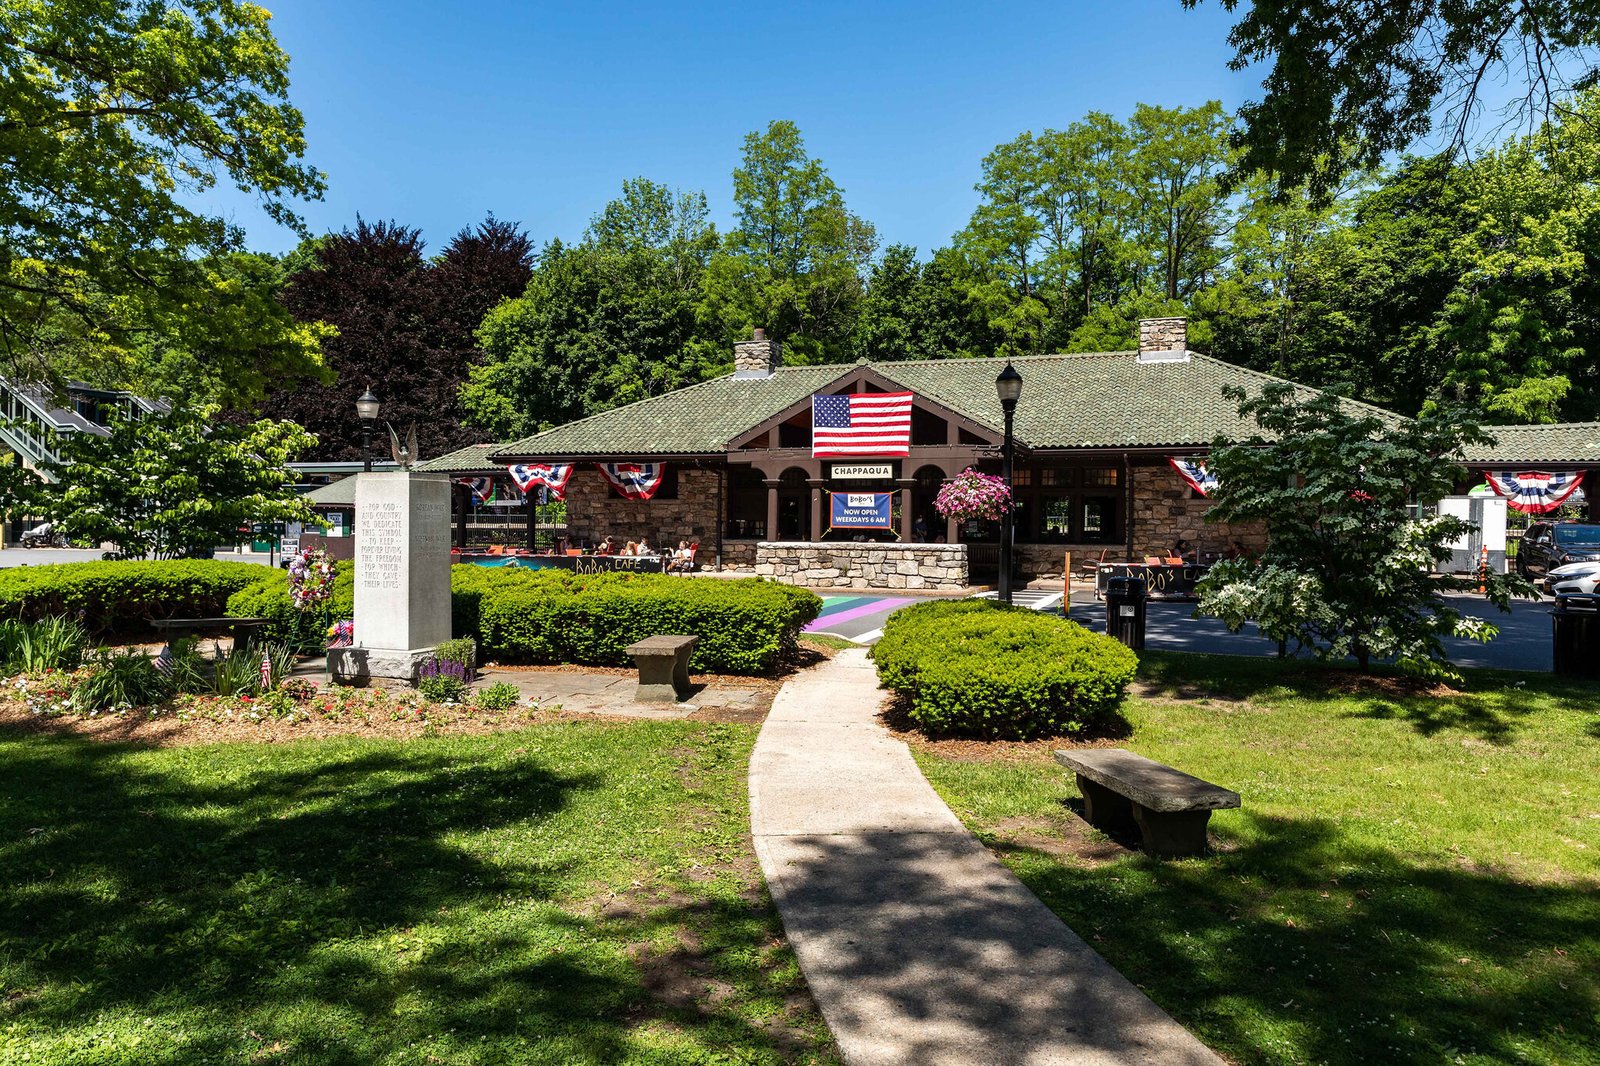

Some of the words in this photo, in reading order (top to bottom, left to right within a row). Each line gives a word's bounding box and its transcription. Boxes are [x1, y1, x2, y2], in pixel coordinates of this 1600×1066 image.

[834, 467, 889, 475] CHAPPAQUA
[368, 503, 379, 511] FOR
[383, 503, 395, 511] GOD
[361, 512, 374, 520] AND
[376, 512, 402, 520] COUNTRY
[362, 529, 375, 537] THIS
[378, 529, 402, 537] SYMBOL
[383, 572, 398, 580] GAVE
[383, 580, 398, 588] LIVES
